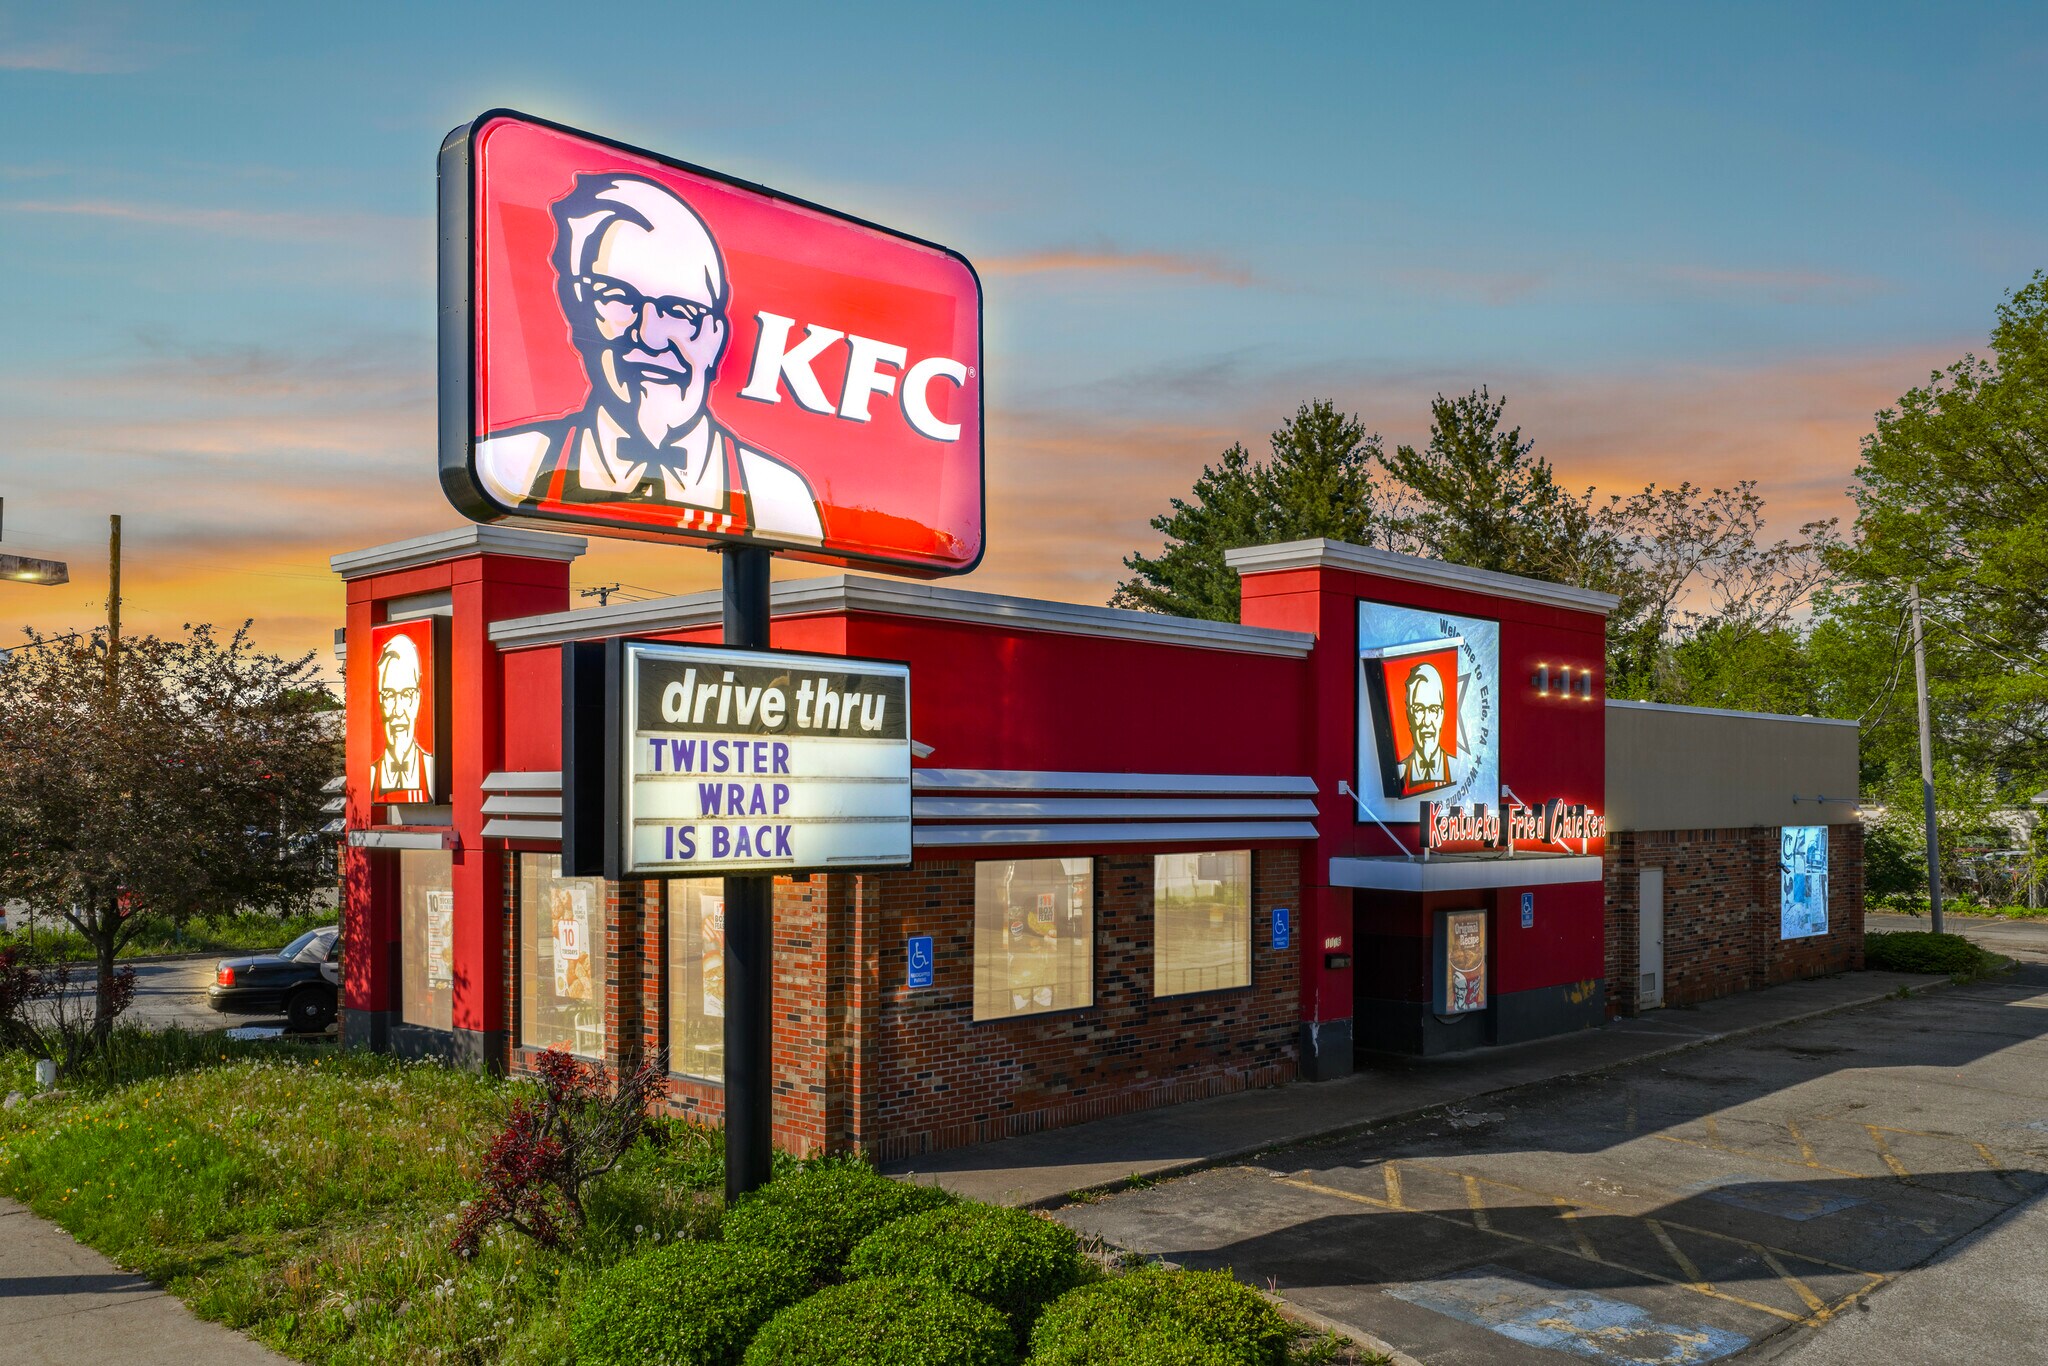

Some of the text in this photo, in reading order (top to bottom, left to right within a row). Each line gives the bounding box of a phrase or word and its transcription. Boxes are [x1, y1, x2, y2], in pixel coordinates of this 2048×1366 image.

[737, 310, 968, 443] KFC
[1474, 664, 1482, 681] to
[661, 668, 887, 731] drive thru
[1480, 684, 1490, 721] Erie,
[1480, 726, 1489, 746] PA
[649, 738, 790, 774] TWISTER
[698, 783, 790, 815] WRAP
[1429, 798, 1607, 848] Kentucky Fried Chicken
[665, 825, 792, 860] IS BACK
[1039, 906, 1053, 914] BOX
[1455, 921, 1478, 936] Original
[1459, 934, 1479, 945] Recipe
